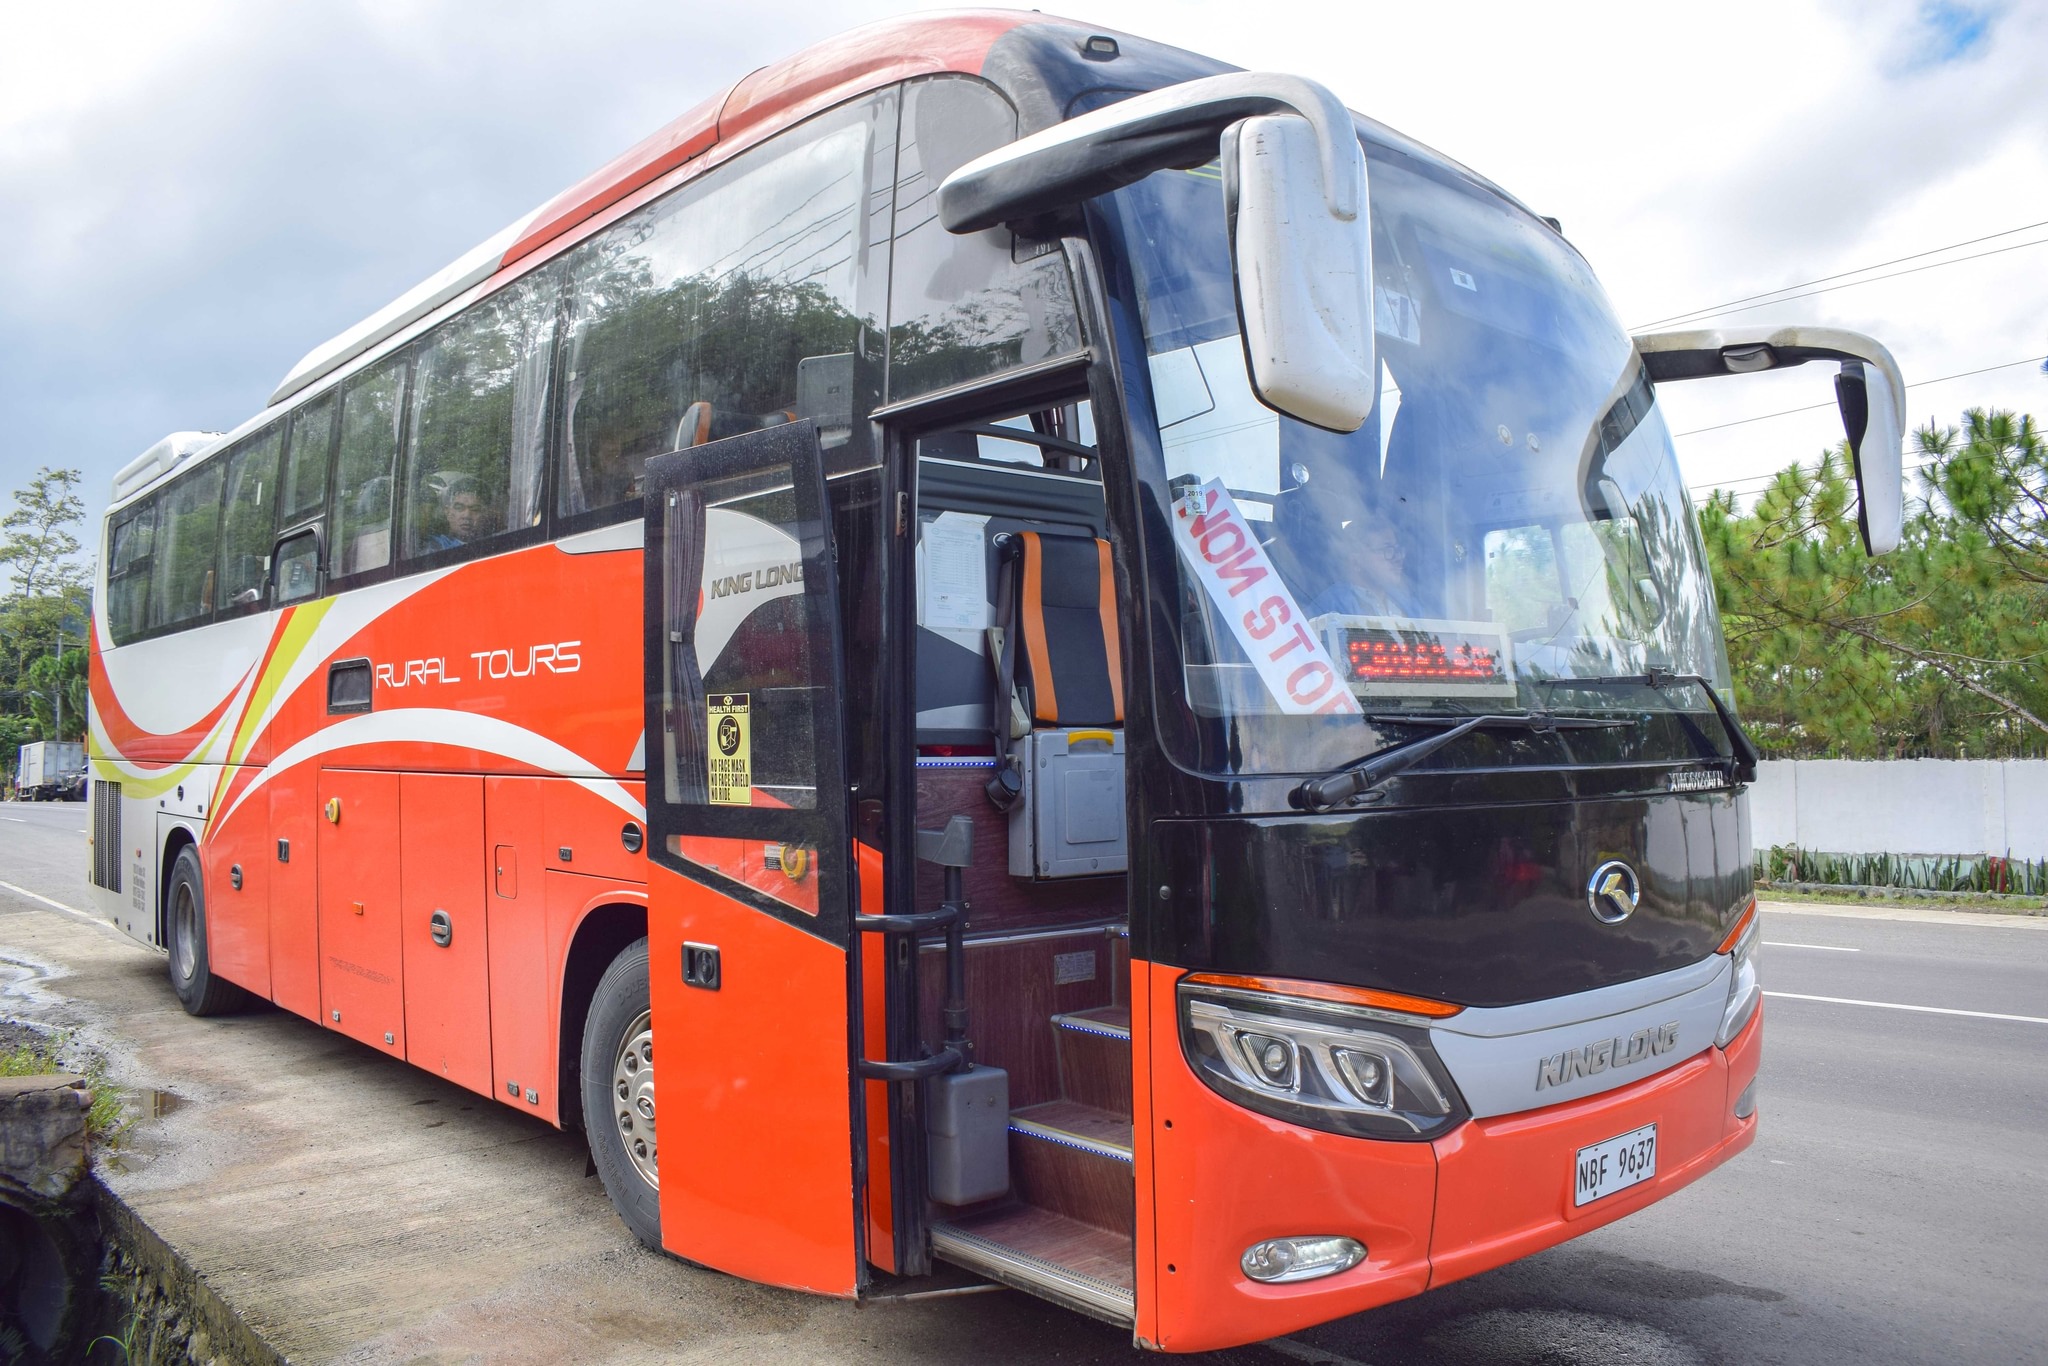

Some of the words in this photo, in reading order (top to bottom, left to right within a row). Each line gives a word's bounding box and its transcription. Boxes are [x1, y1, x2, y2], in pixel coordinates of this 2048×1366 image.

[711, 571, 753, 600] KING
[755, 562, 804, 590] LONG
[376, 656, 461, 689] RURAL
[470, 640, 582, 681] TOURS
[709, 705, 731, 714] HEALTH
[731, 704, 749, 713] FIRST
[710, 758, 718, 773] NO
[718, 758, 731, 773] FACE
[731, 758, 746, 773] MASK
[710, 773, 718, 787] NO
[718, 773, 731, 787] FACE
[731, 773, 749, 787] SHIELD
[710, 787, 718, 801] NO
[718, 787, 731, 801] RIDE
[1535, 1038, 1612, 1091] KING
[1612, 1020, 1681, 1068] LONG
[1579, 1153, 1609, 1193] NBF
[1619, 1136, 1655, 1178] 9637
